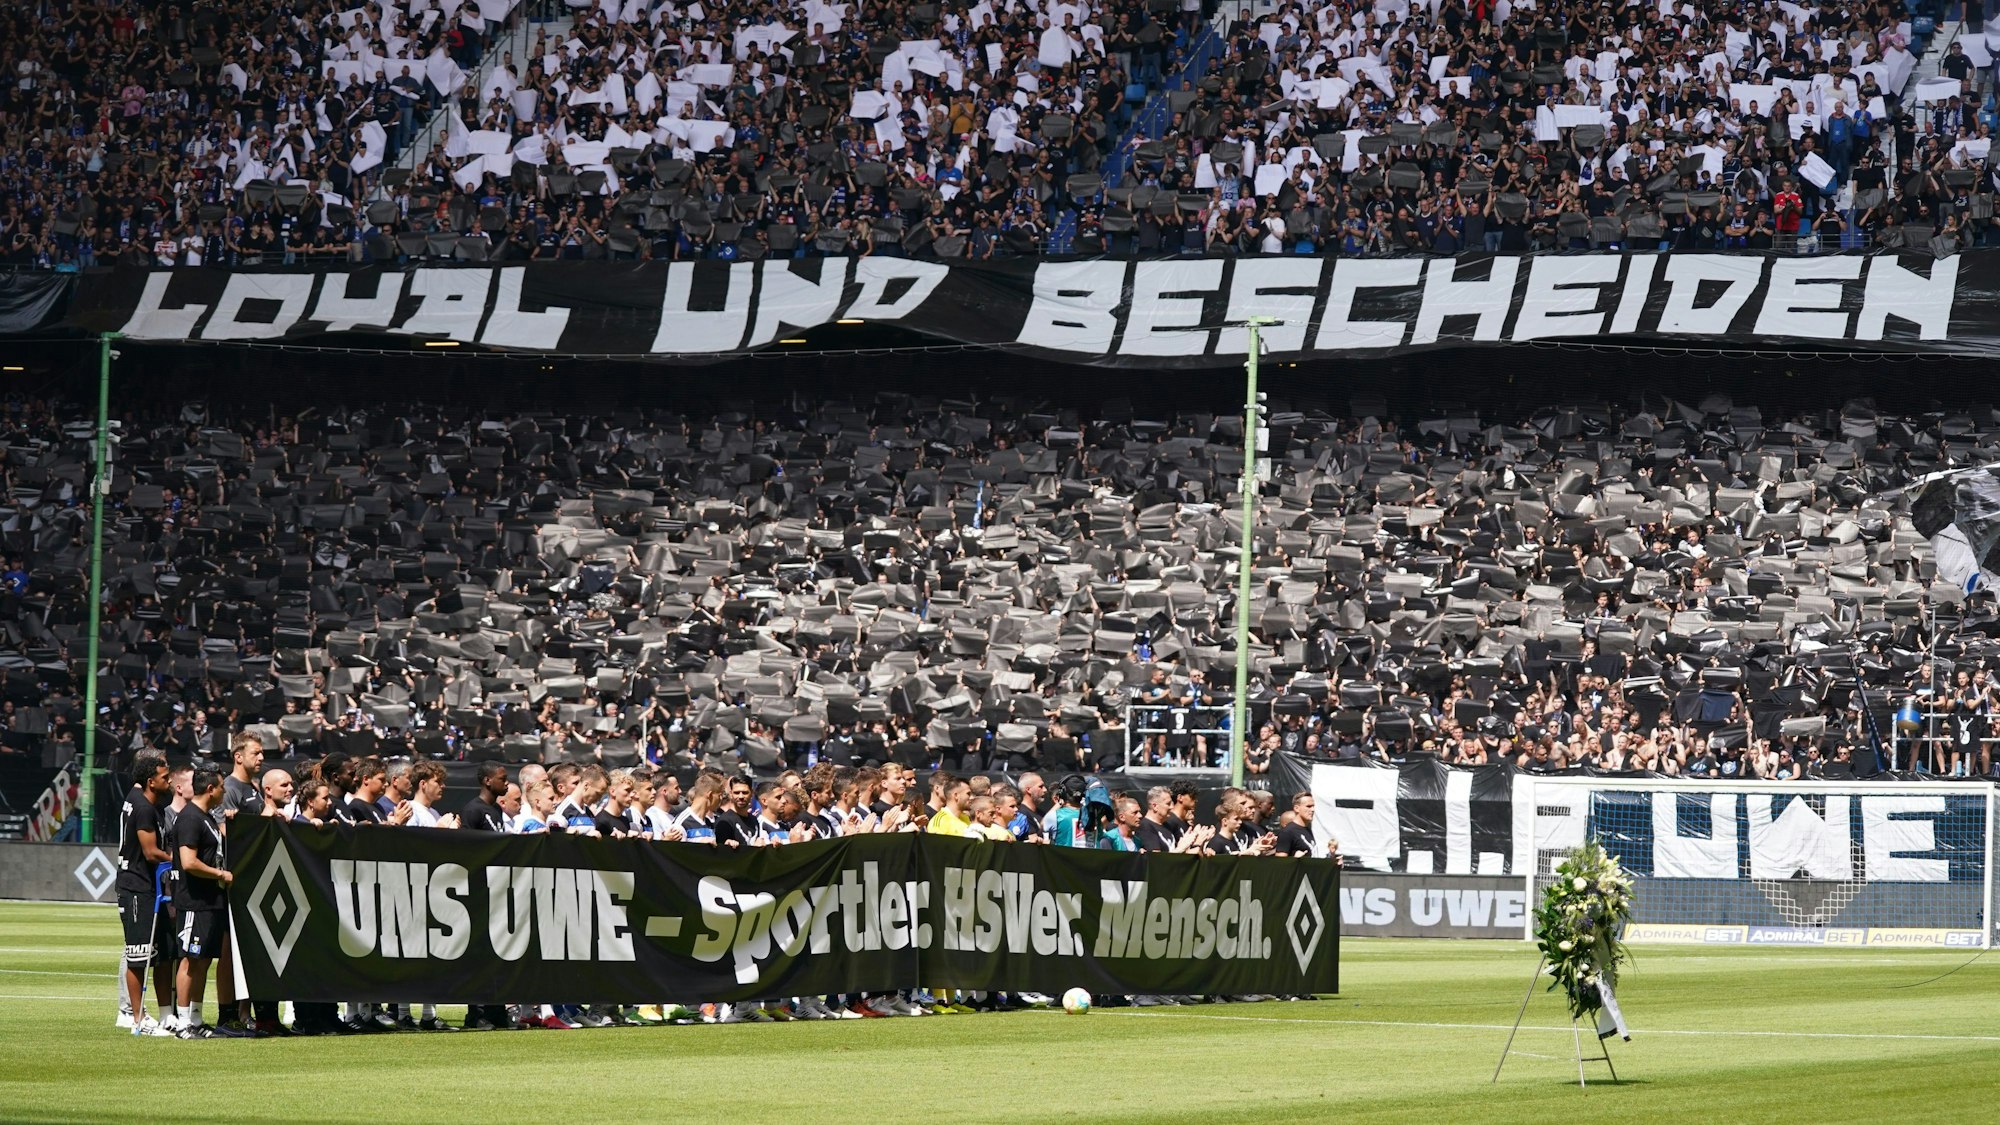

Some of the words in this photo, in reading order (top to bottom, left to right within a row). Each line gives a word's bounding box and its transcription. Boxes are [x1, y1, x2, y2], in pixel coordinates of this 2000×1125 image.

[118, 266, 571, 349] LOYAL
[650, 255, 950, 353] UND
[1016, 254, 1961, 356] BESCHEIDEN
[1175, 712, 1185, 730] 9
[1651, 792, 1950, 882] UWE
[329, 858, 472, 961] UNS
[485, 865, 637, 962] UWE
[690, 860, 933, 984] Sportler.
[943, 867, 1084, 957] HSVer.
[1095, 878, 1272, 960] Mensch.
[1340, 887, 1397, 926] NS
[1409, 888, 1526, 928] UWE
